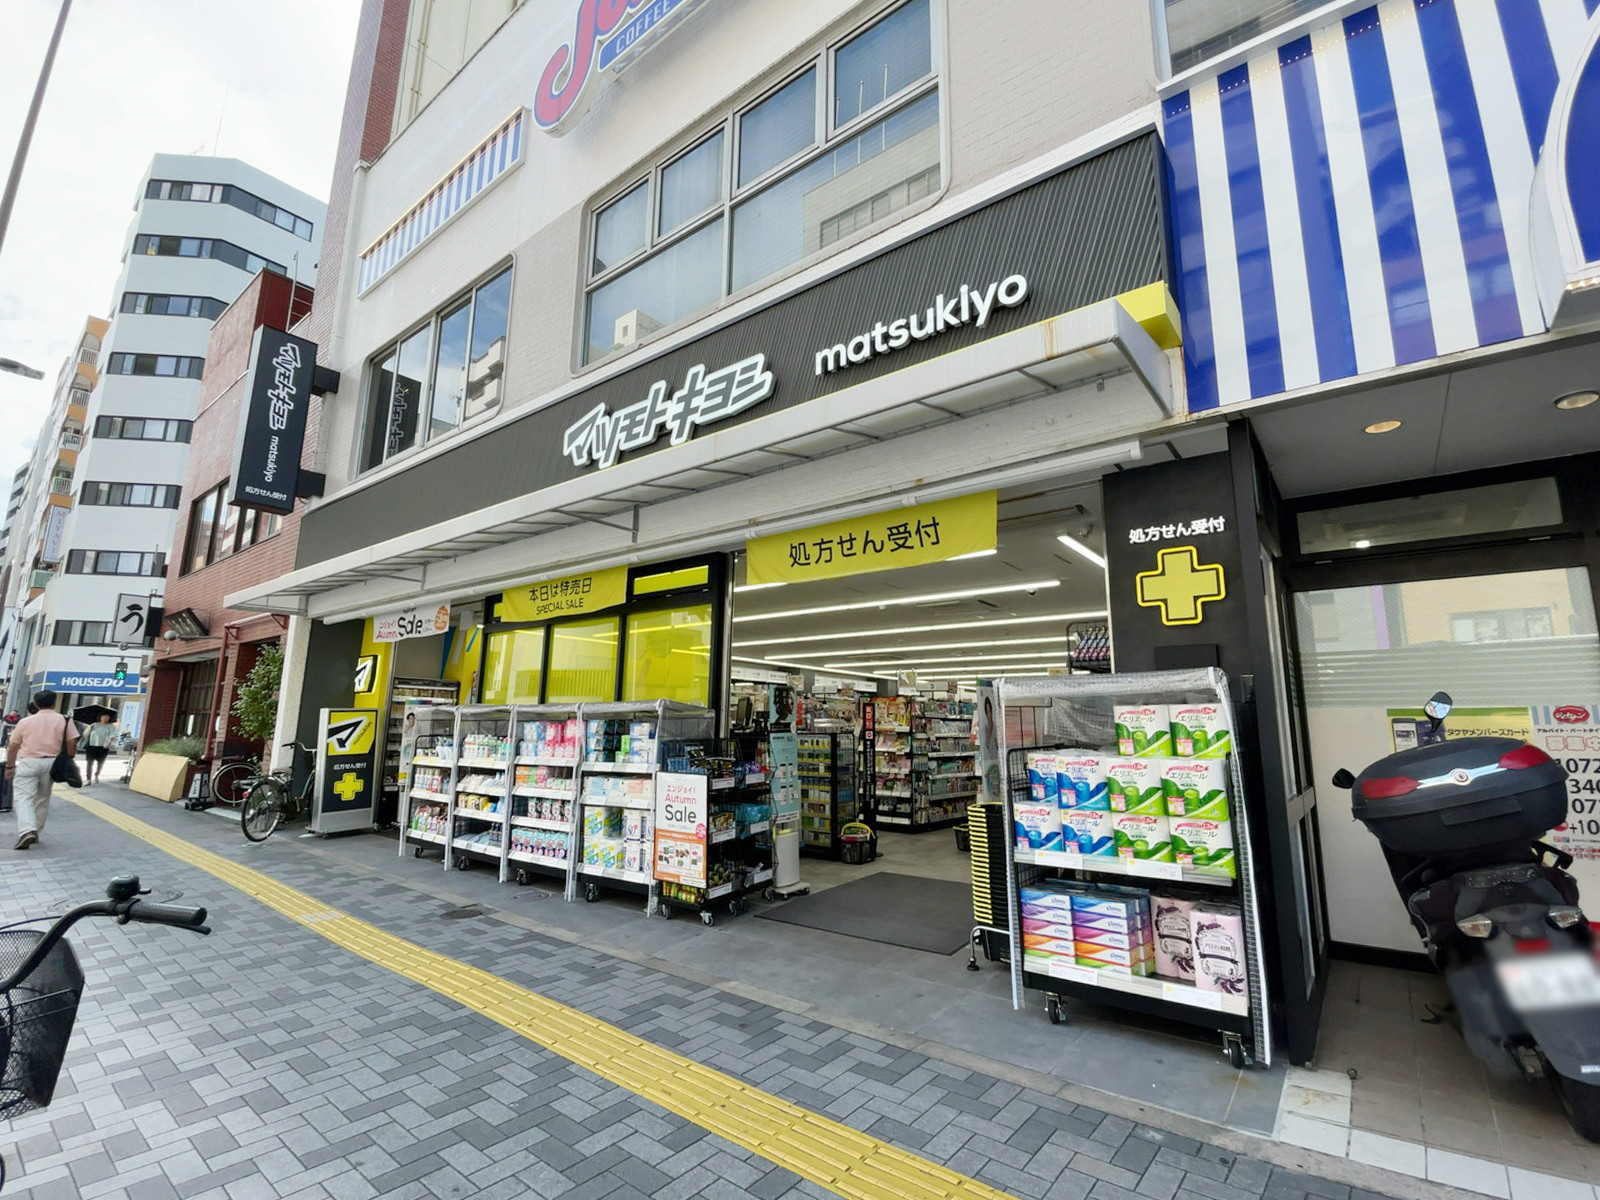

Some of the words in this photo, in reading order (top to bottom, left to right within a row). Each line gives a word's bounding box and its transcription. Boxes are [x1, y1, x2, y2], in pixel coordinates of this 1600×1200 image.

[616, 0, 671, 53] COFFEE
[815, 273, 1029, 377] matsukiyo
[267, 343, 301, 431] マツモトキヨシ
[563, 353, 777, 470] マツモトキヨシ
[263, 436, 279, 482] matsukiyo
[789, 516, 940, 568] 処方せん受付
[1128, 515, 1226, 544] 処方せん受付
[528, 577, 592, 603] 本日は特売日
[536, 602, 564, 615] SPECIAL
[566, 598, 584, 609] SALE
[120, 603, 144, 636] う
[664, 793, 697, 805] Autumn
[664, 803, 697, 824] Sale
